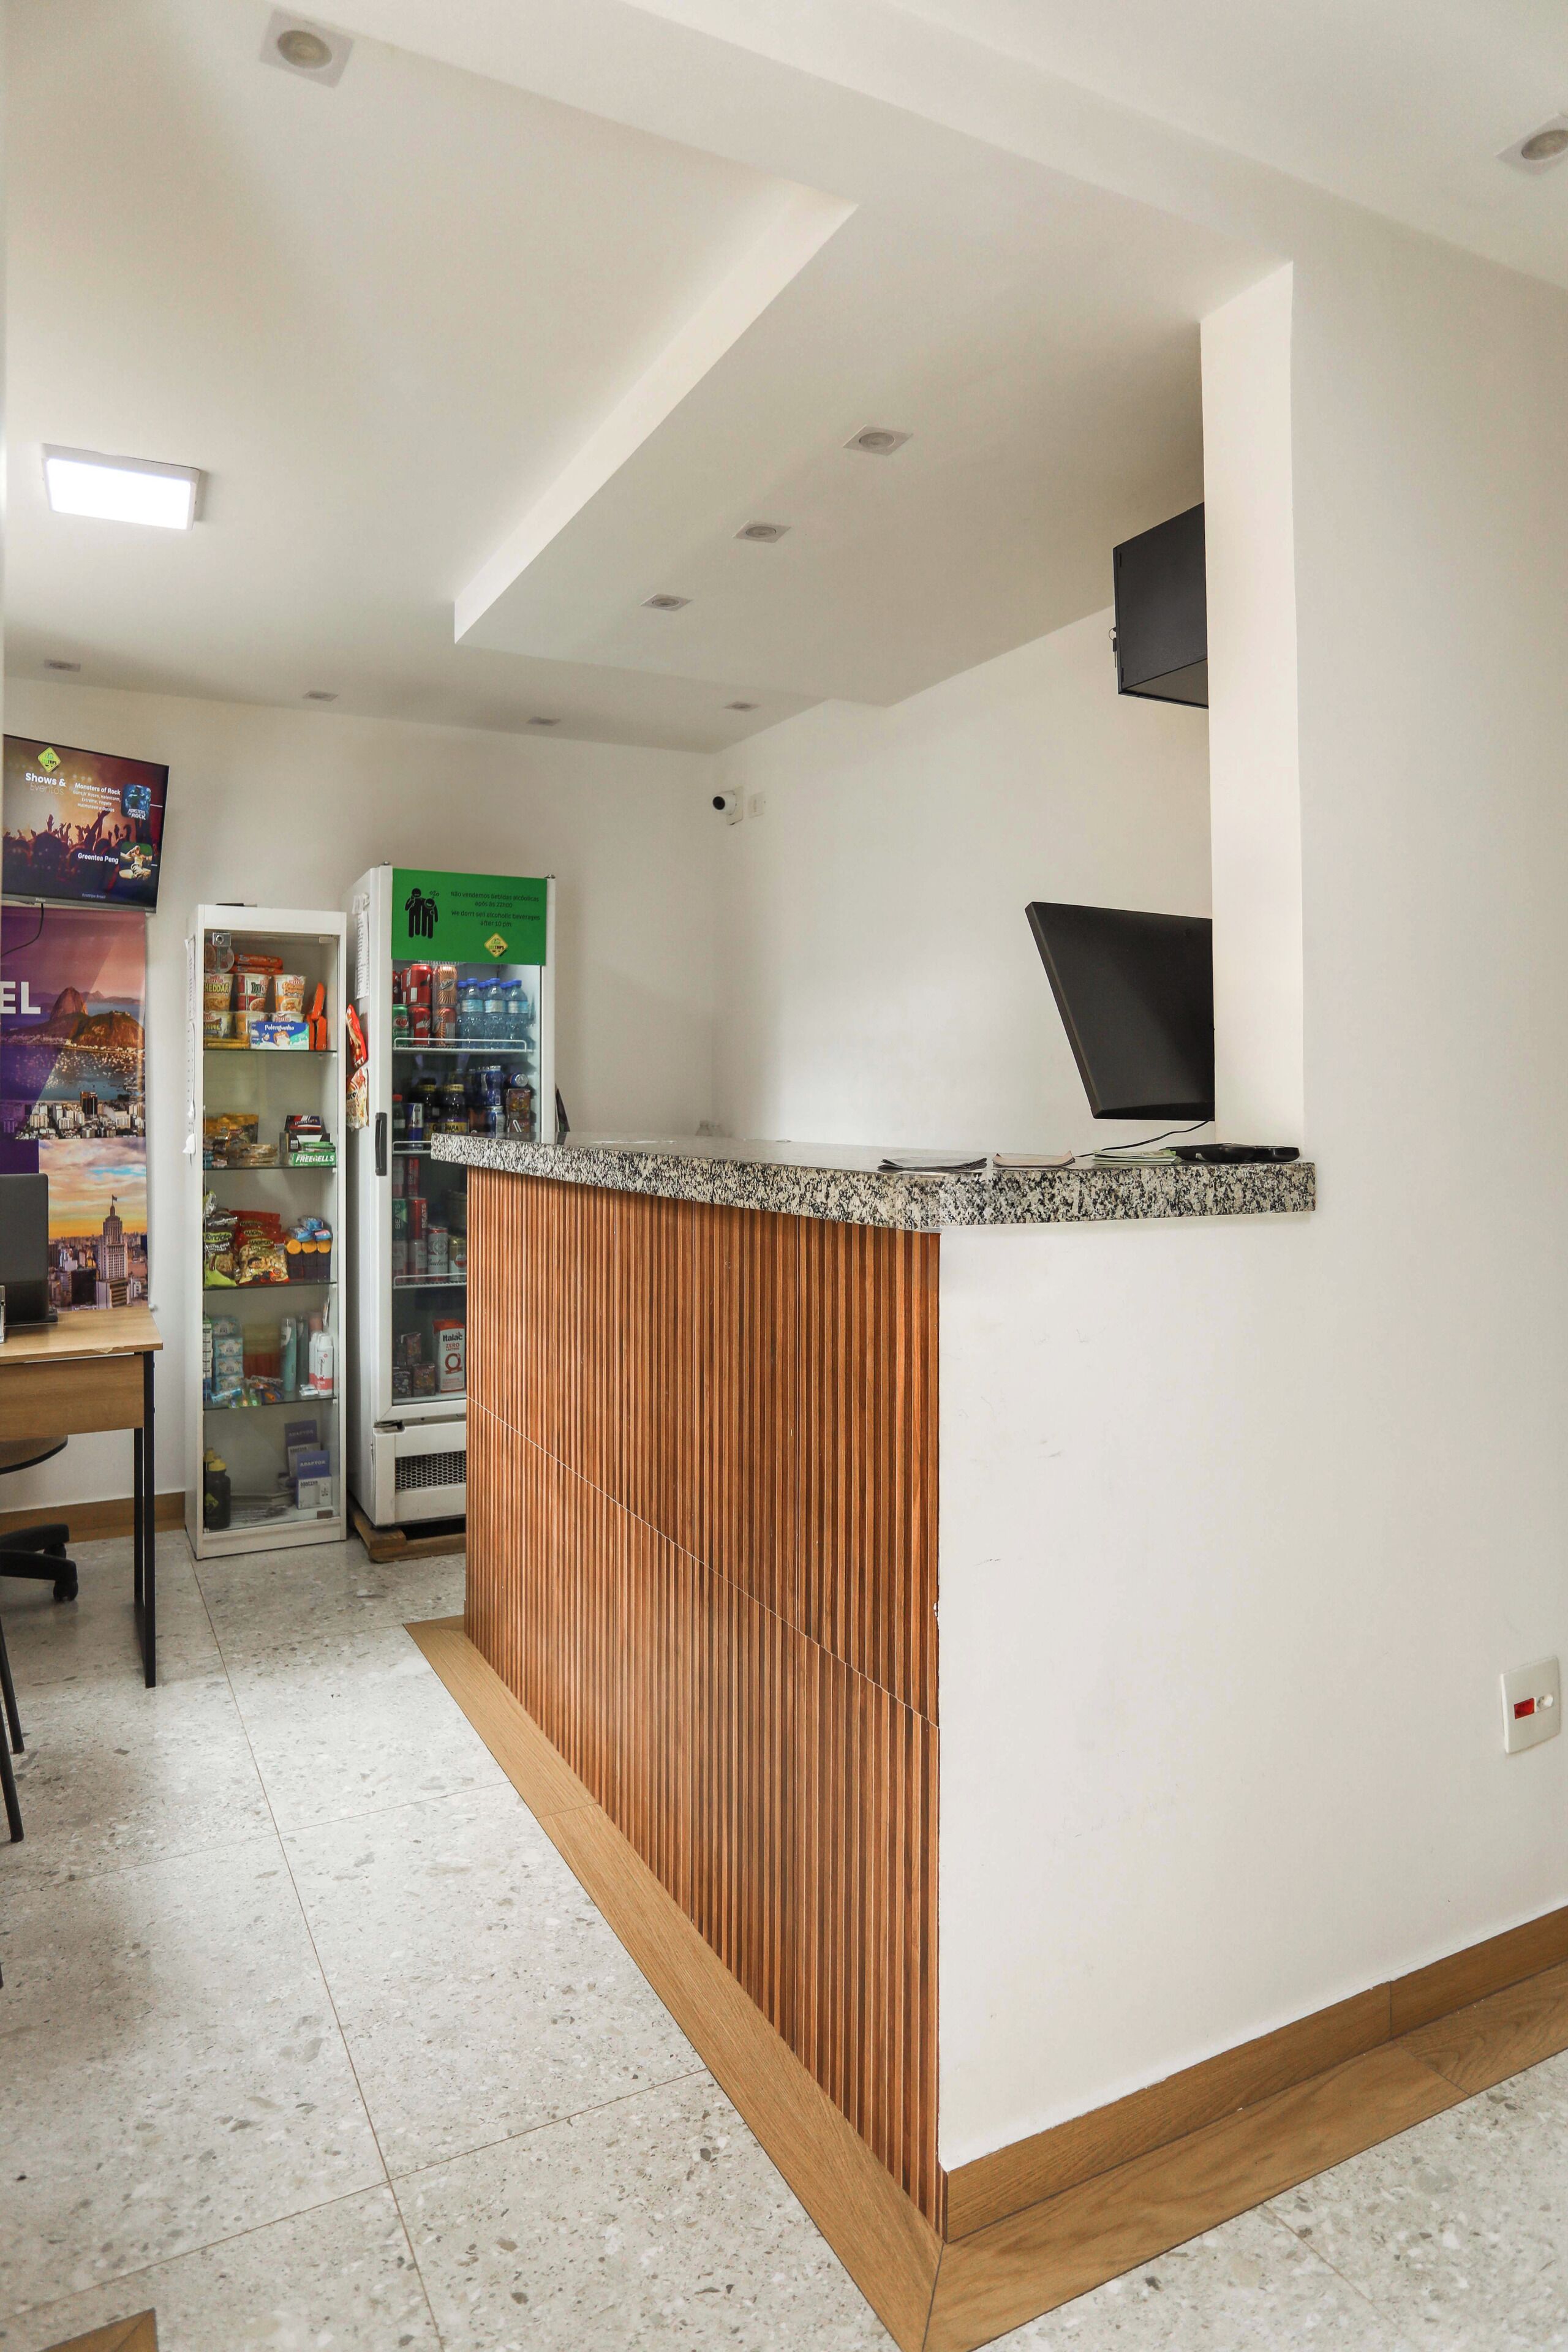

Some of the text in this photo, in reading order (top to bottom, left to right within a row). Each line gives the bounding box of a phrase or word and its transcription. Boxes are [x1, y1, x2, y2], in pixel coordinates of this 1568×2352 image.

[25, 772, 67, 787] Shows &
[30, 782, 64, 795] Eventos
[75, 782, 100, 792] Monsters
[78, 853, 119, 865] Greentea Peng
[205, 982, 230, 993] HEDDAR
[295, 1155, 334, 1163] FREEGELLS
[443, 1333, 463, 1342] Italac
